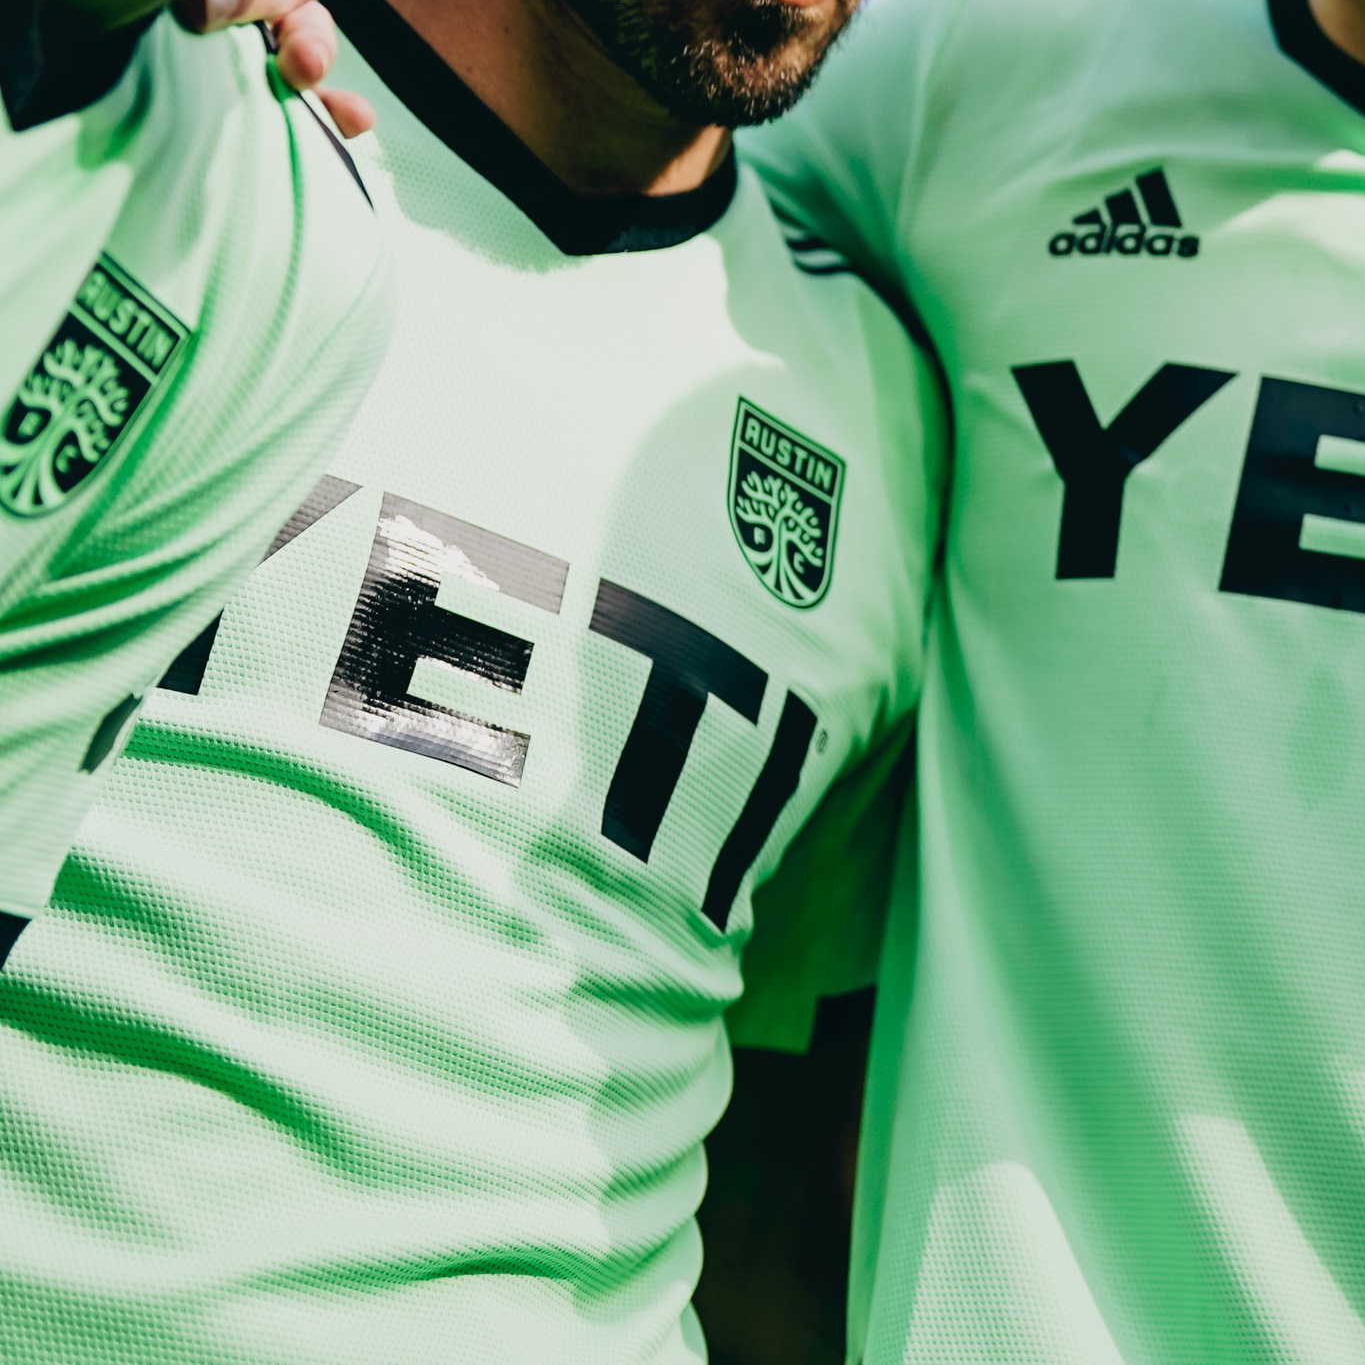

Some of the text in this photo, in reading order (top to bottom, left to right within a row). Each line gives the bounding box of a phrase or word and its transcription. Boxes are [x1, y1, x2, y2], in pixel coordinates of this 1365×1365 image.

[1048, 224, 1200, 258] adidas
[76, 270, 175, 369] AUSTIN
[745, 417, 833, 490] AUSTIN
